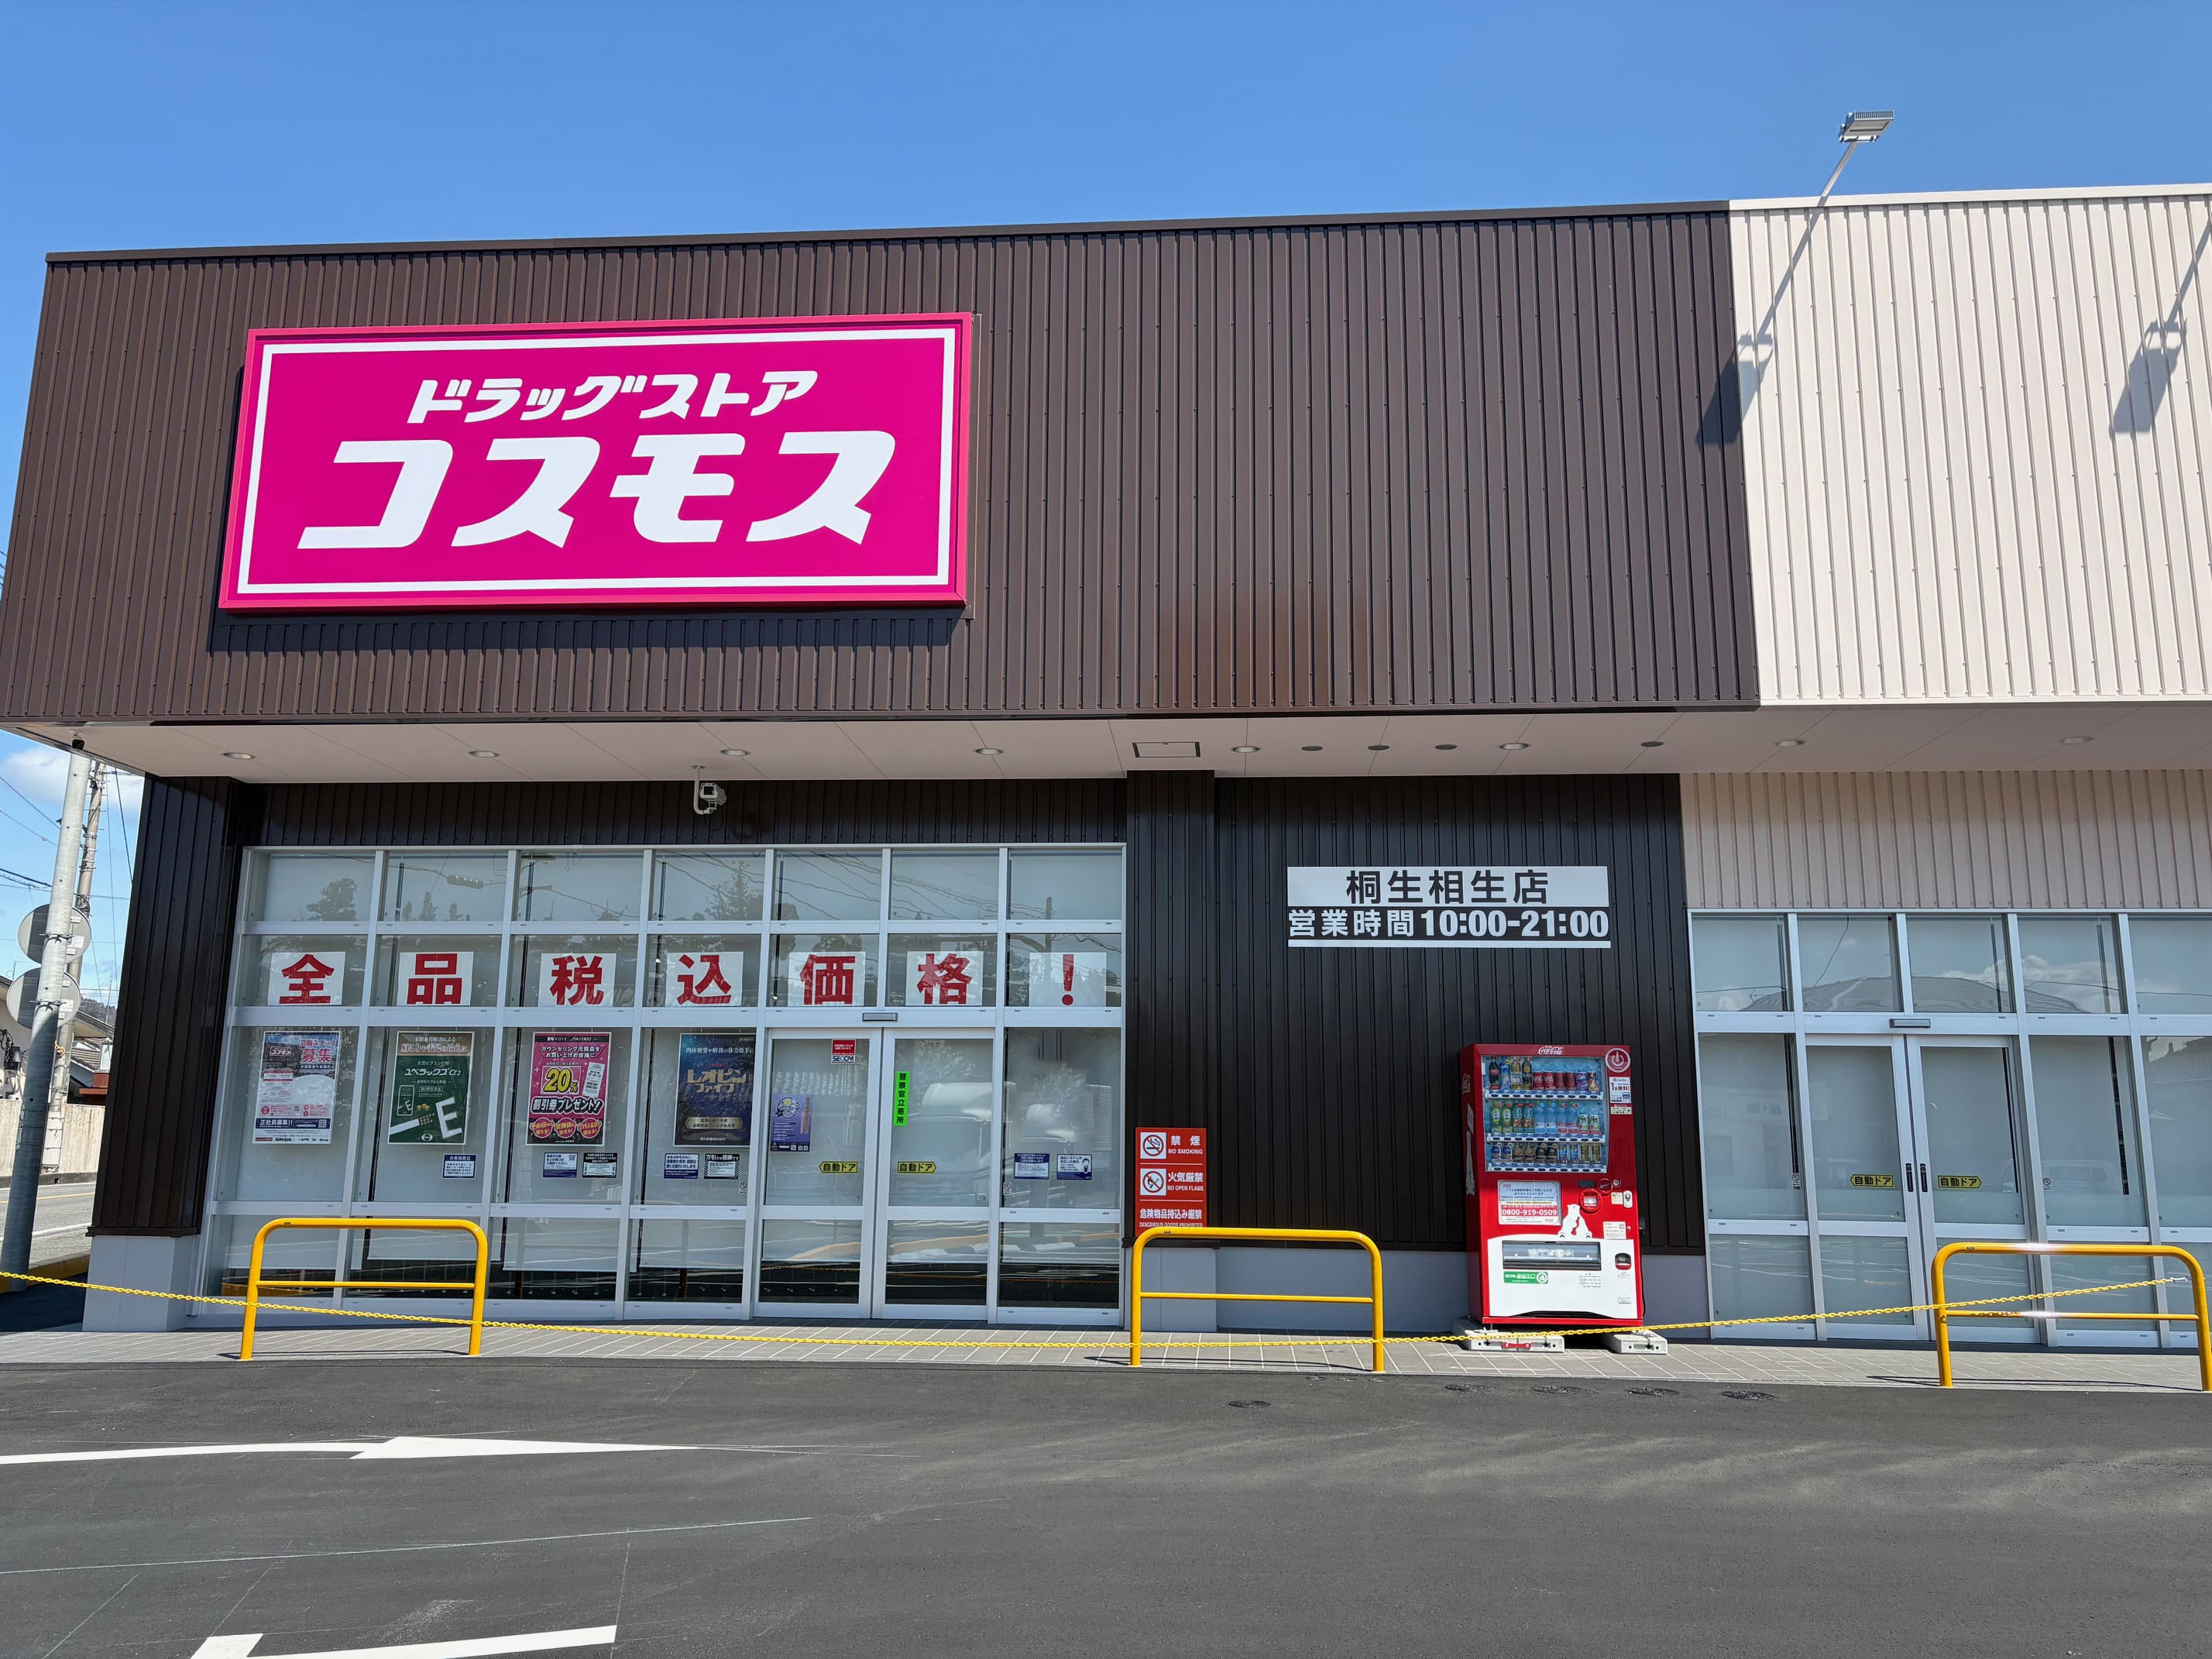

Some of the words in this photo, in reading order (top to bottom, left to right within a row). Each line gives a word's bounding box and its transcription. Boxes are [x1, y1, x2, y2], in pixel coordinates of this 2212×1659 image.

[407, 371, 818, 424] ドラッグストア
[297, 430, 896, 548] コスモス
[1346, 870, 1548, 905] 桐生相生店
[301, 1048, 332, 1063] 募集
[687, 1069, 746, 1084] レオピン
[533, 1097, 603, 1111] 割引券プレゼント!
[897, 1073, 906, 1125] 警察官立寄所
[823, 1163, 856, 1171] 自動ドア
[899, 1163, 933, 1172] 自動ドア
[1168, 1172, 1204, 1183] 火気厳禁
[1854, 1176, 1891, 1185] 自動ドア
[1940, 1177, 1977, 1186] 自動ドア
[1140, 1209, 1202, 1219] 危険物品持込み厳禁
